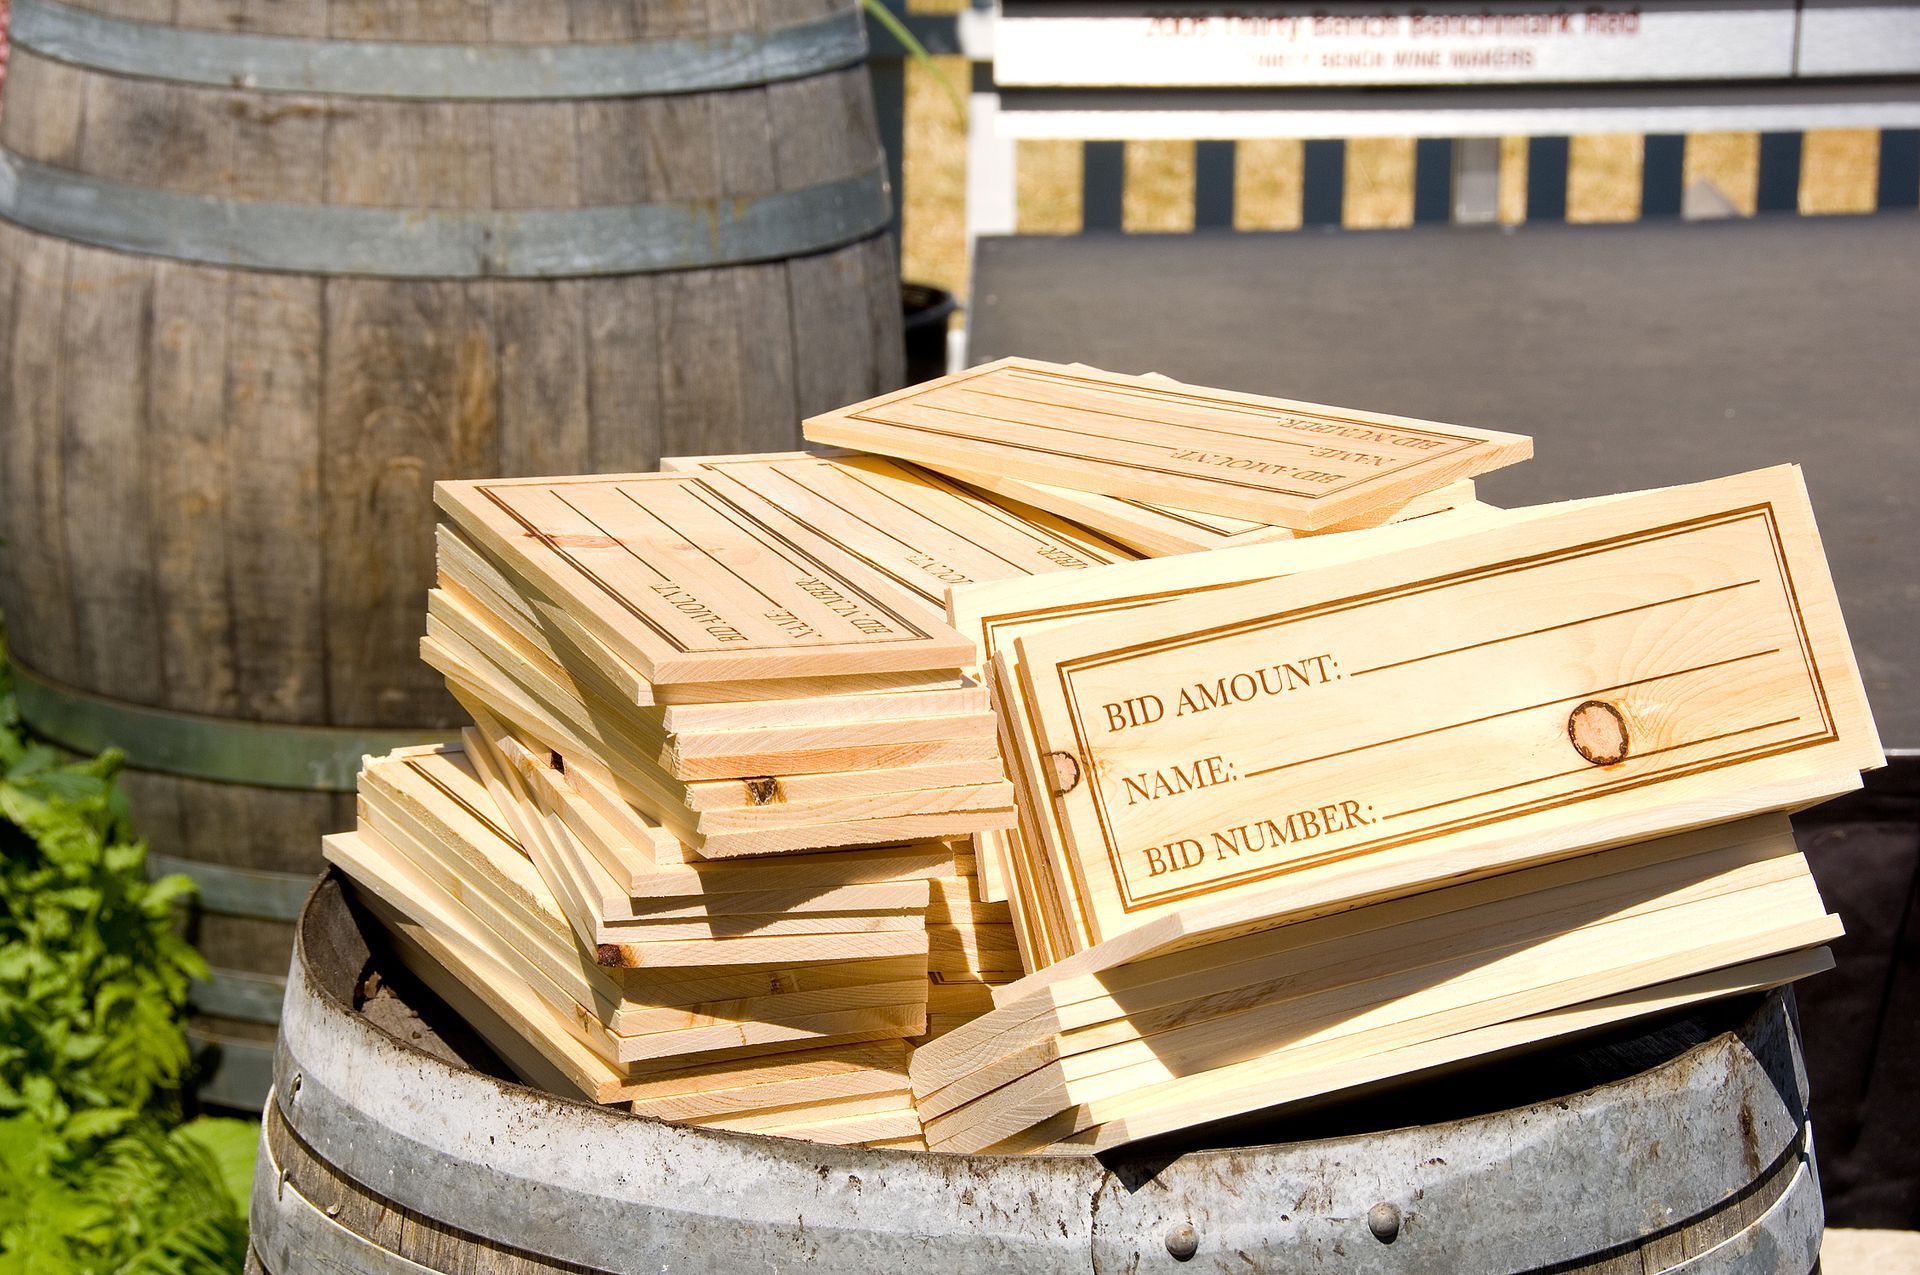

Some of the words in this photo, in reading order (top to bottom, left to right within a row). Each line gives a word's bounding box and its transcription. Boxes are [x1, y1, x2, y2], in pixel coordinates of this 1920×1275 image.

[1102, 694, 1164, 733] BID
[1176, 654, 1341, 717] AMOUNT:
[1122, 755, 1238, 806] NAME:
[1142, 838, 1205, 877] BID
[1210, 799, 1377, 861] NUMBER:
